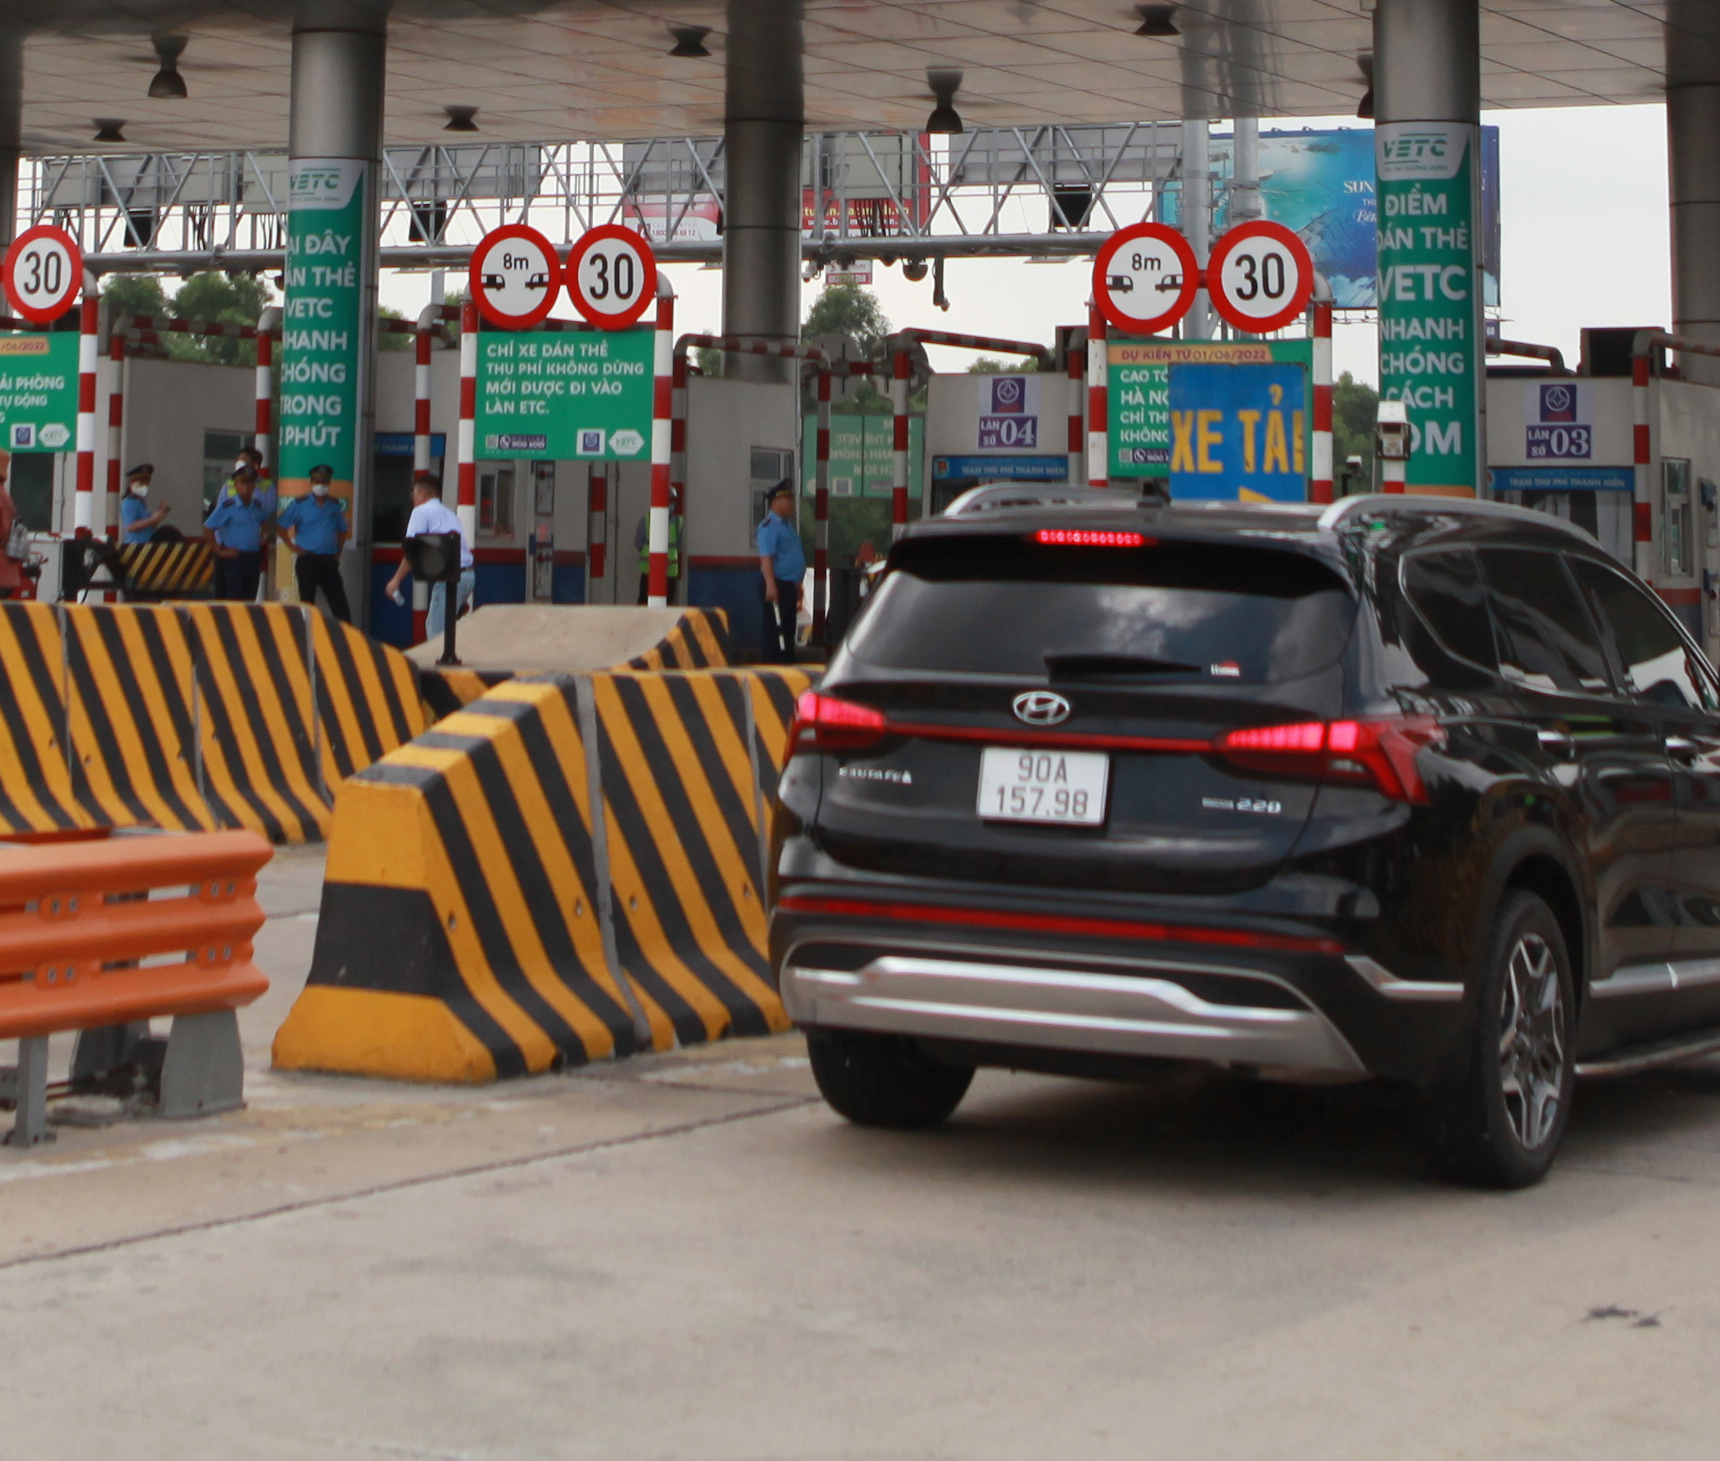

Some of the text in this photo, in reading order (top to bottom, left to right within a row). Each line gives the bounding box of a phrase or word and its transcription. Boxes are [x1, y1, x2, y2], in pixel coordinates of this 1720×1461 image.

[1383, 139, 1448, 158] VETC
[1384, 183, 1448, 216] ĐIỂM
[305, 229, 352, 255] ĐÂY
[1420, 220, 1469, 250] THẺ
[23, 250, 62, 295] 30
[311, 261, 357, 287] THẺ
[503, 252, 634, 300] 8m 30
[1131, 252, 1285, 301] 8m 30
[1380, 264, 1467, 302] VETC
[286, 297, 334, 318] VETC
[1380, 317, 1465, 341] NHANH
[486, 340, 609, 358] CHỈ XE DÁN THẺ
[1121, 349, 1139, 363] DỰ
[1143, 346, 1172, 360] KIẾN
[1380, 344, 1465, 375] CHÓNG
[486, 358, 645, 375] THU PHÍ KHÔNG DỪNG
[1120, 370, 1149, 383] CAO
[15, 372, 66, 391] PHÒNG
[486, 377, 623, 398] MỚI ĐƯỢC ĐI VÀO
[485, 397, 550, 415] LÀN ETC.
[1120, 385, 1145, 406] HÀ
[1120, 407, 1145, 424] CHỈ
[284, 420, 342, 447] PHÚT
[980, 419, 1035, 445] LÀN 04
[1170, 384, 1305, 474] XE TẢI
[1528, 428, 1589, 455] LÀN 03
[1531, 444, 1546, 456] SỐ
[1016, 753, 1069, 784] 90A
[995, 786, 1089, 818] 157.98
